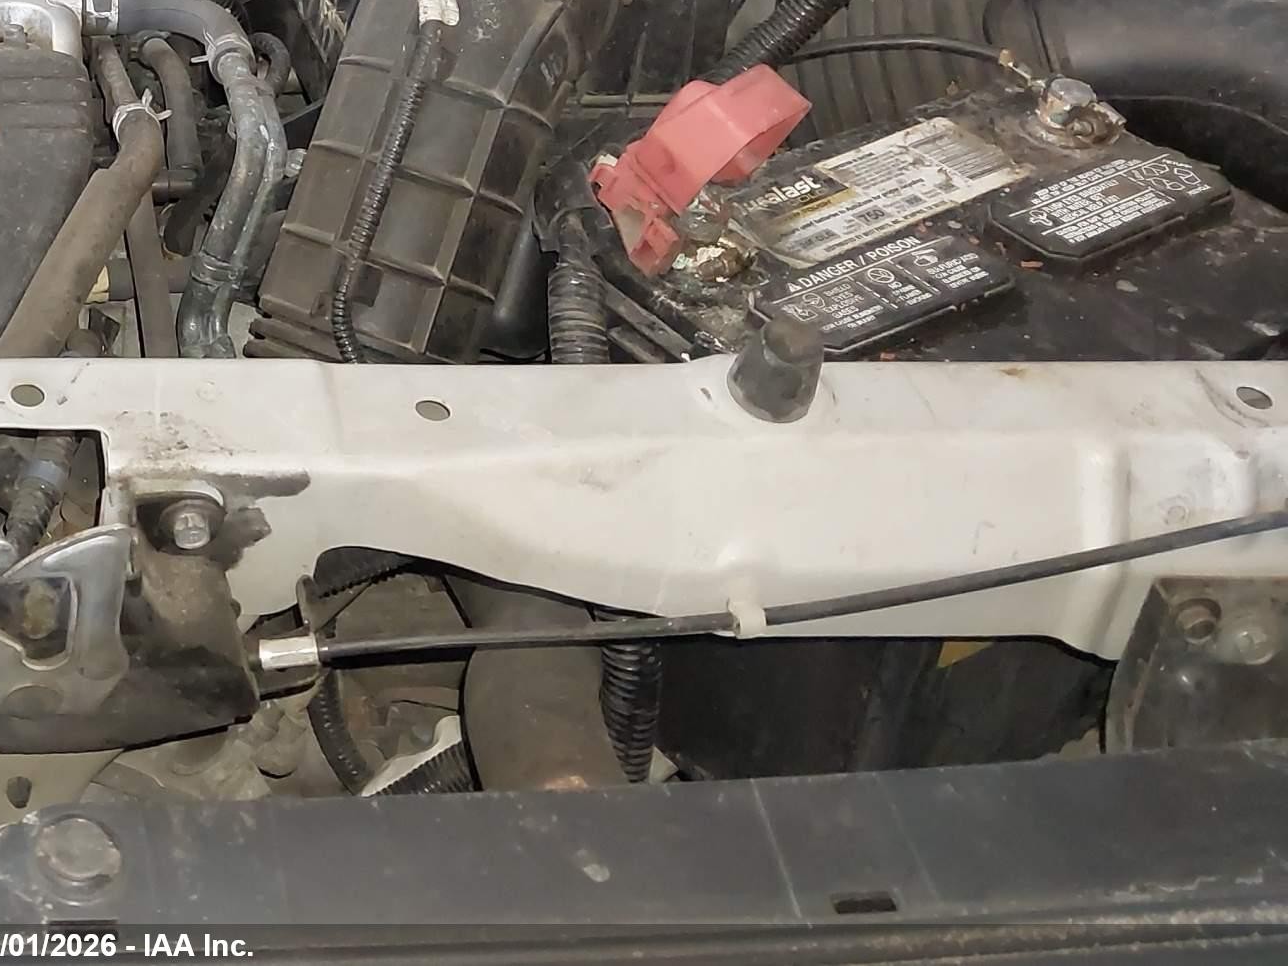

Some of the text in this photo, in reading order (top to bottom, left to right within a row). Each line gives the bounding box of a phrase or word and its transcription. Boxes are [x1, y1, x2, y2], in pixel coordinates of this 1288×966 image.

[857, 208, 885, 223] 750
[798, 259, 861, 289] DANGER
[860, 254, 867, 266] /
[865, 235, 922, 262] POISON
